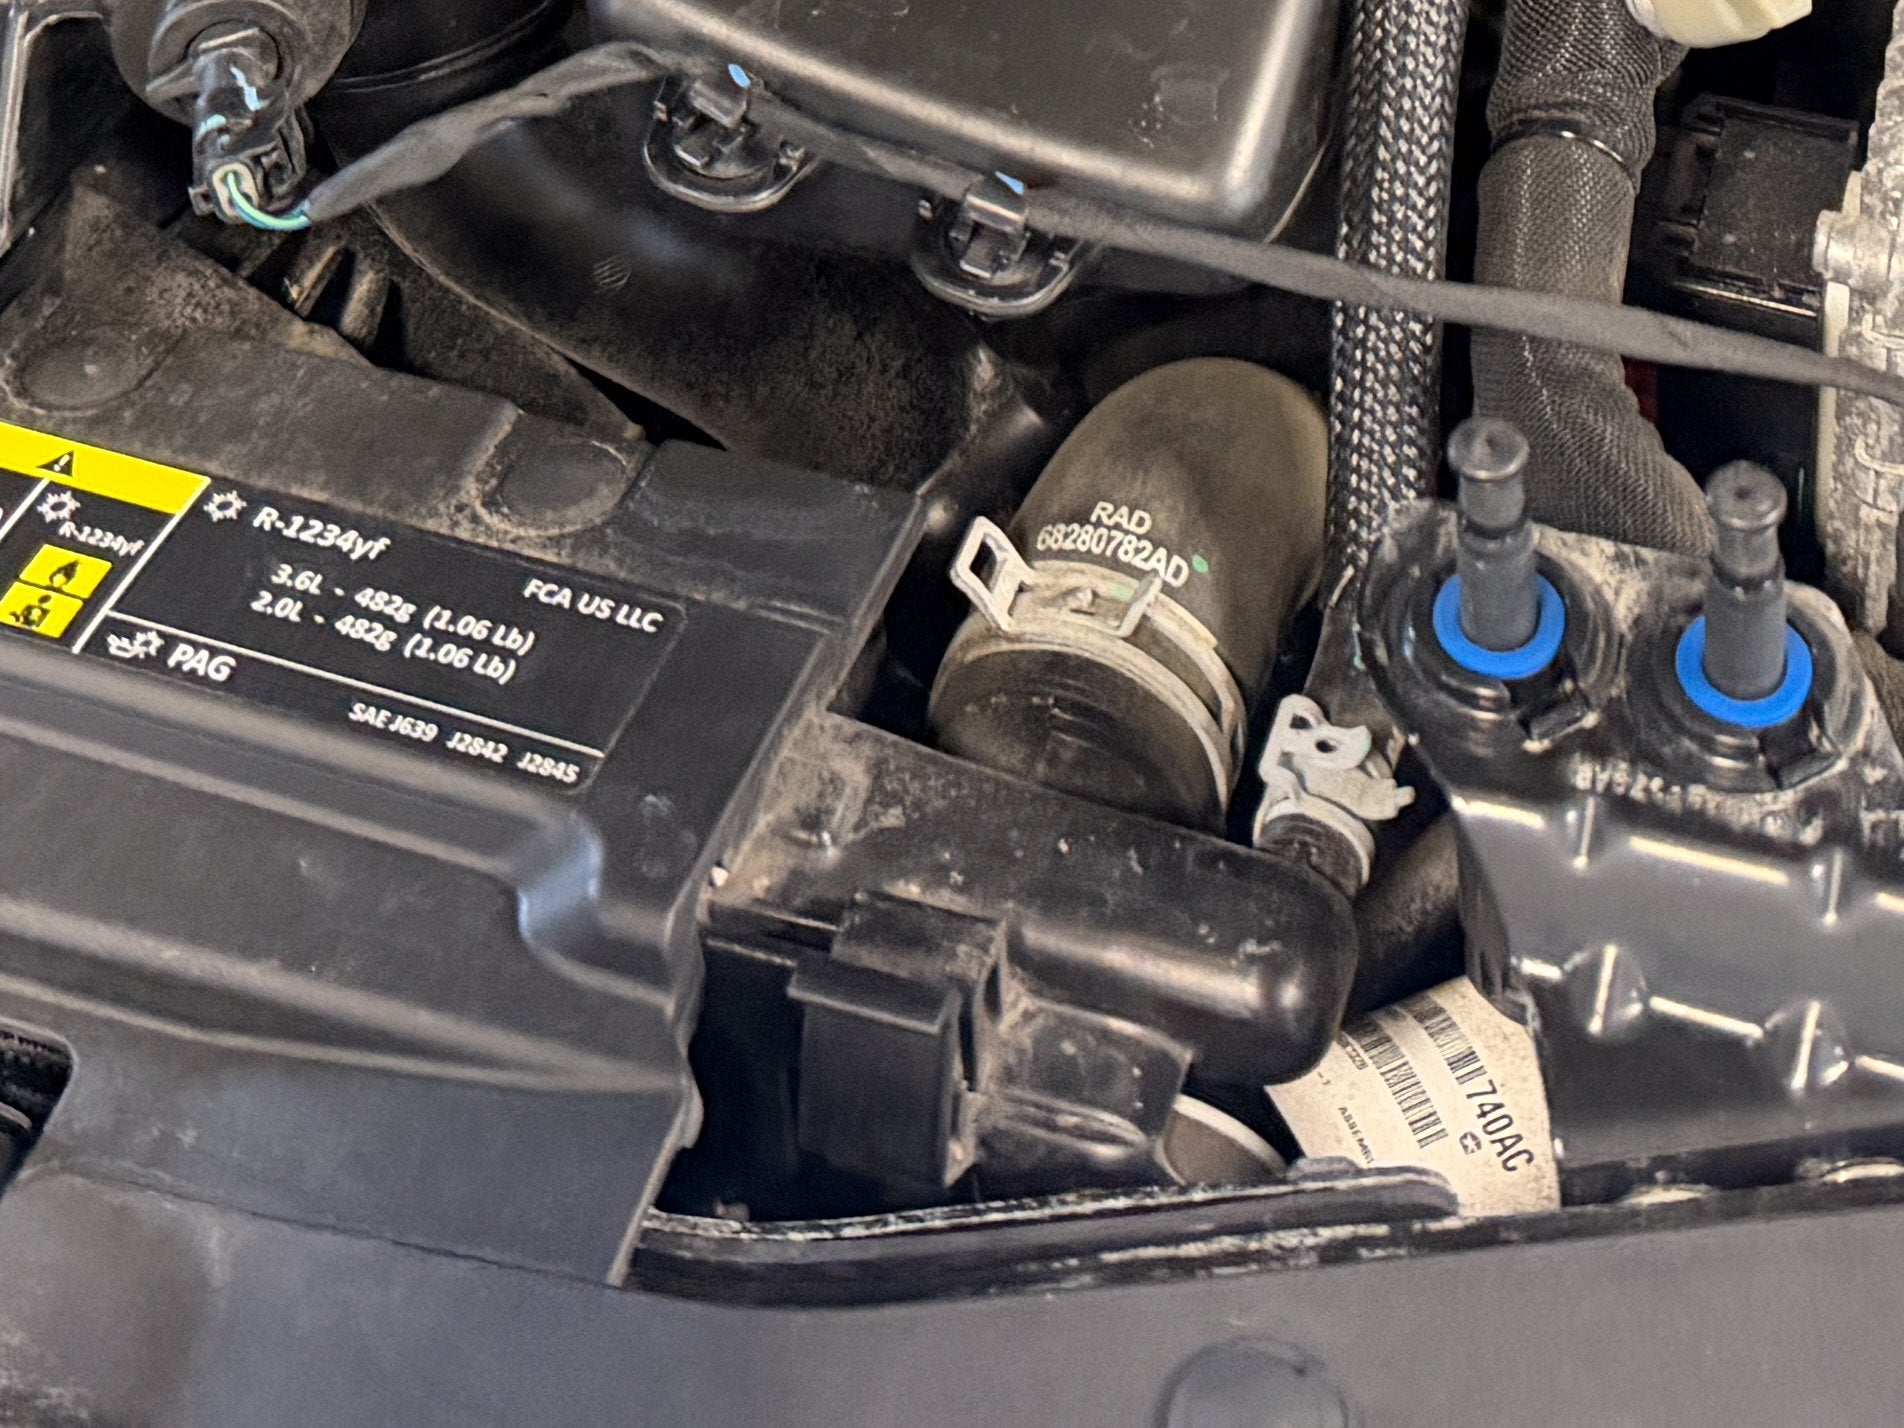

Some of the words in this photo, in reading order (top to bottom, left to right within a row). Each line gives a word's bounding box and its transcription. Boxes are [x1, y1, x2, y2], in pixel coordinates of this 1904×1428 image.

[58, 521, 146, 558] R-1234yf
[253, 505, 392, 561] R-1234yf
[1089, 500, 1152, 535] RAD
[1036, 522, 1190, 588] 68280782AD
[271, 563, 324, 597] 3.6L
[354, 587, 417, 625] 482g
[424, 604, 491, 641] (1.06
[492, 622, 536, 657] Lb)
[522, 577, 573, 613] FCA
[576, 591, 616, 621] US
[616, 601, 665, 634] LLC
[166, 642, 238, 683] PAG
[250, 590, 304, 624] 2.0L
[334, 614, 398, 653] 482g
[404, 631, 470, 669] (1.06
[472, 651, 517, 686] Lb)
[347, 701, 392, 731] SAE
[391, 712, 439, 744] J639
[446, 728, 510, 765] J2842
[516, 750, 580, 786] J2845
